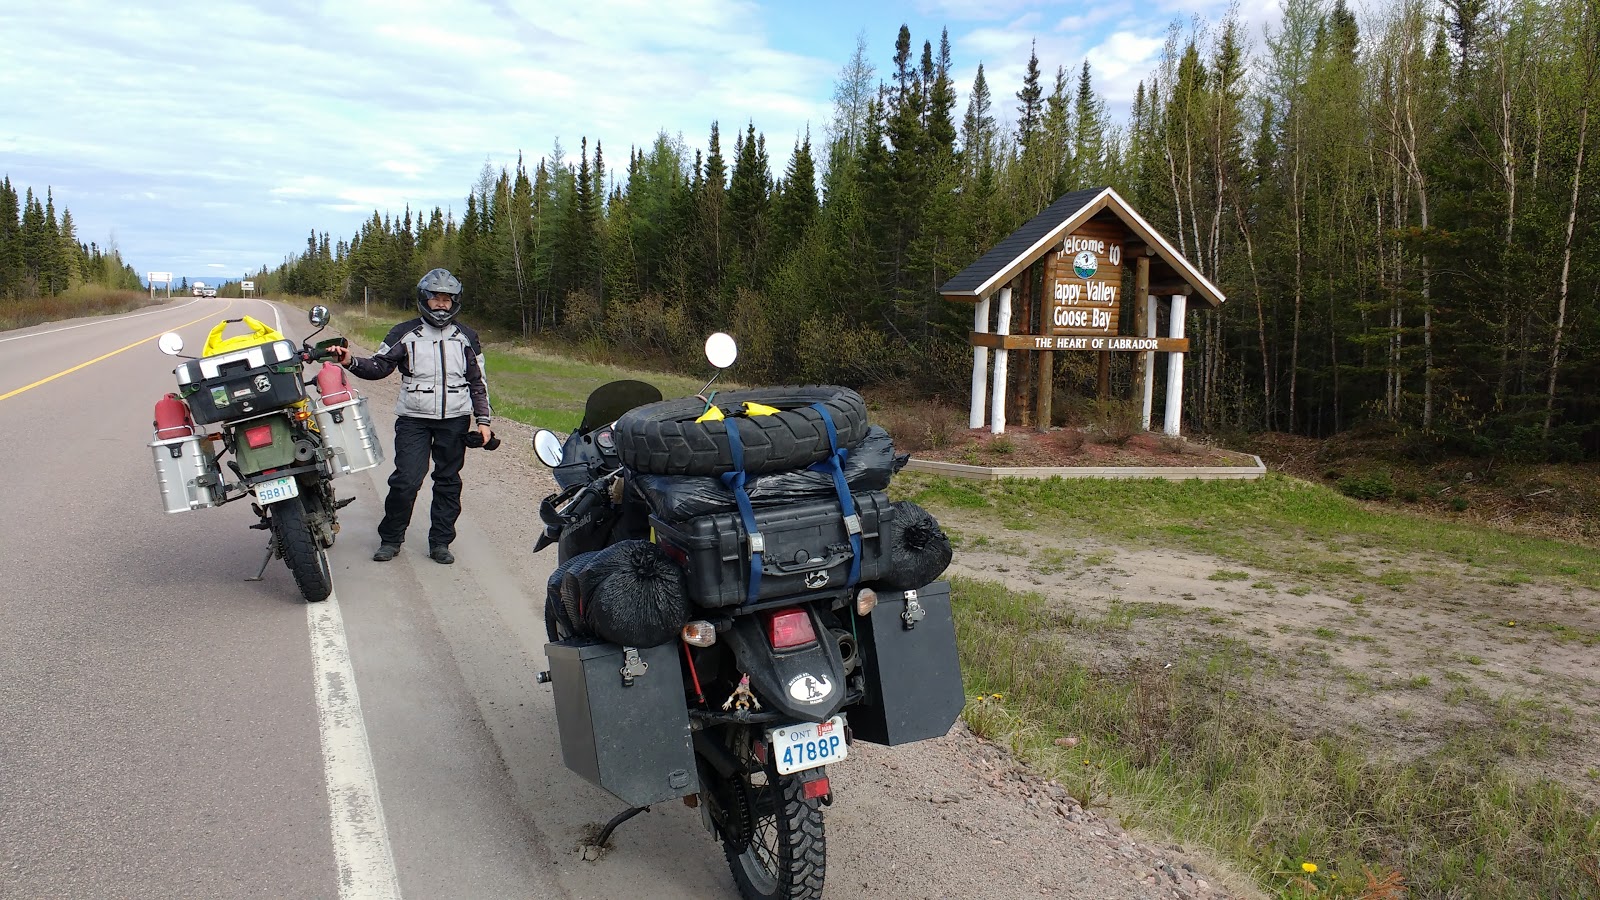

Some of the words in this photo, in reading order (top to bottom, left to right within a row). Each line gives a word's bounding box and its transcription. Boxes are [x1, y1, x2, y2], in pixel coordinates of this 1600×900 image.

[1110, 243, 1120, 266] to
[1087, 281, 1116, 306] Valley
[1054, 306, 1087, 326] Goose
[1092, 308, 1111, 331] Bay
[1035, 338, 1052, 348] THE
[1057, 338, 1087, 349] HEART
[1092, 339, 1104, 349] OF
[1109, 339, 1158, 349] LABRADOR
[260, 485, 293, 500] 5B811
[783, 735, 840, 766] 4788P
